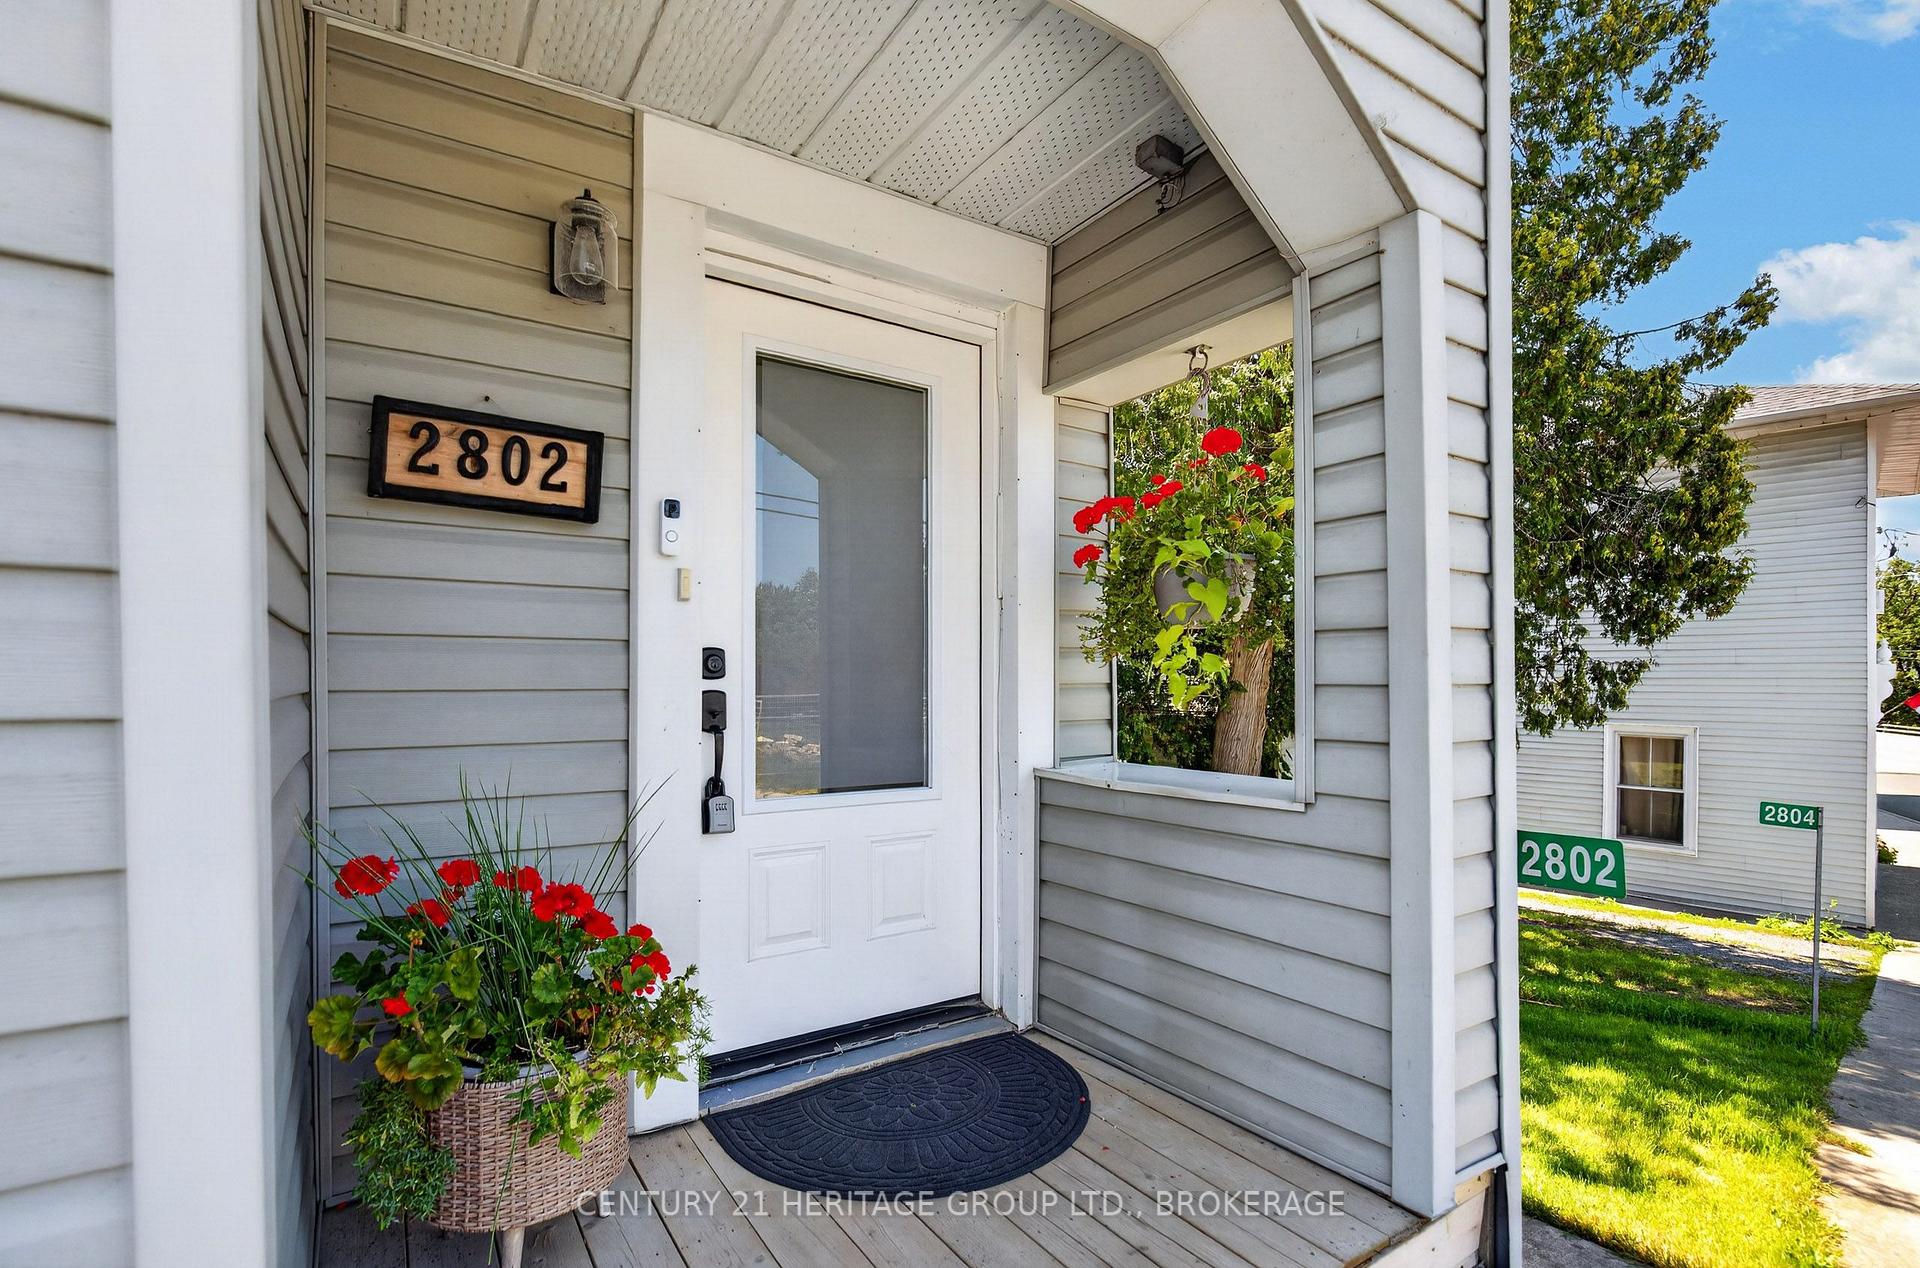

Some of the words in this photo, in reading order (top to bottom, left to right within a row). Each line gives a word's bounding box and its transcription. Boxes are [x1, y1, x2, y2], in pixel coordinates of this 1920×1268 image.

[407, 421, 569, 493] 2802
[1764, 805, 1816, 827] 2804
[1521, 839, 1618, 889] 2802
